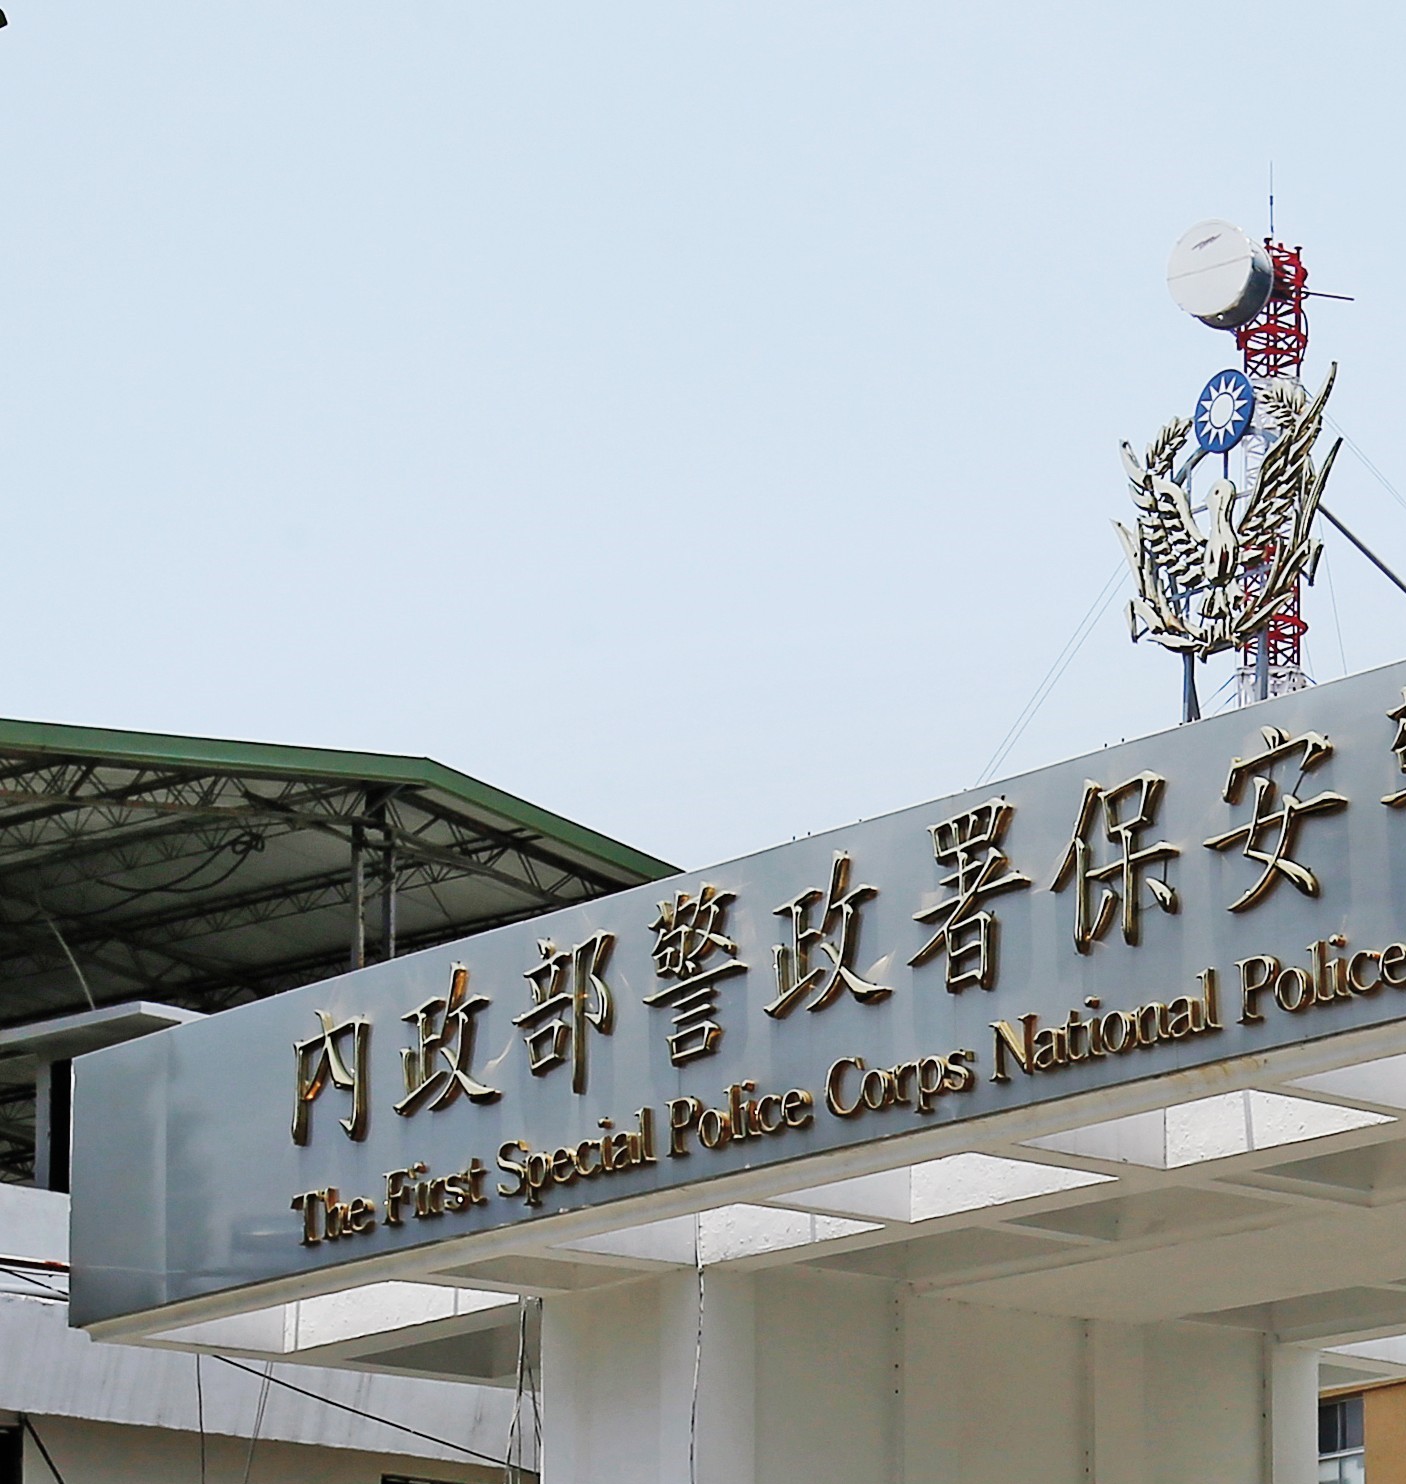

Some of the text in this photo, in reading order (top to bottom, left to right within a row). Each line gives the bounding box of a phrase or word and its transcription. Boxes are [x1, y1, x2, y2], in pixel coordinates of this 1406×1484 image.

[290, 1186, 376, 1246] The
[381, 1158, 491, 1226] First
[495, 1107, 657, 1207] Special
[666, 1079, 814, 1157] Police
[824, 1048, 976, 1115] Corps
[989, 966, 1224, 1083] National
